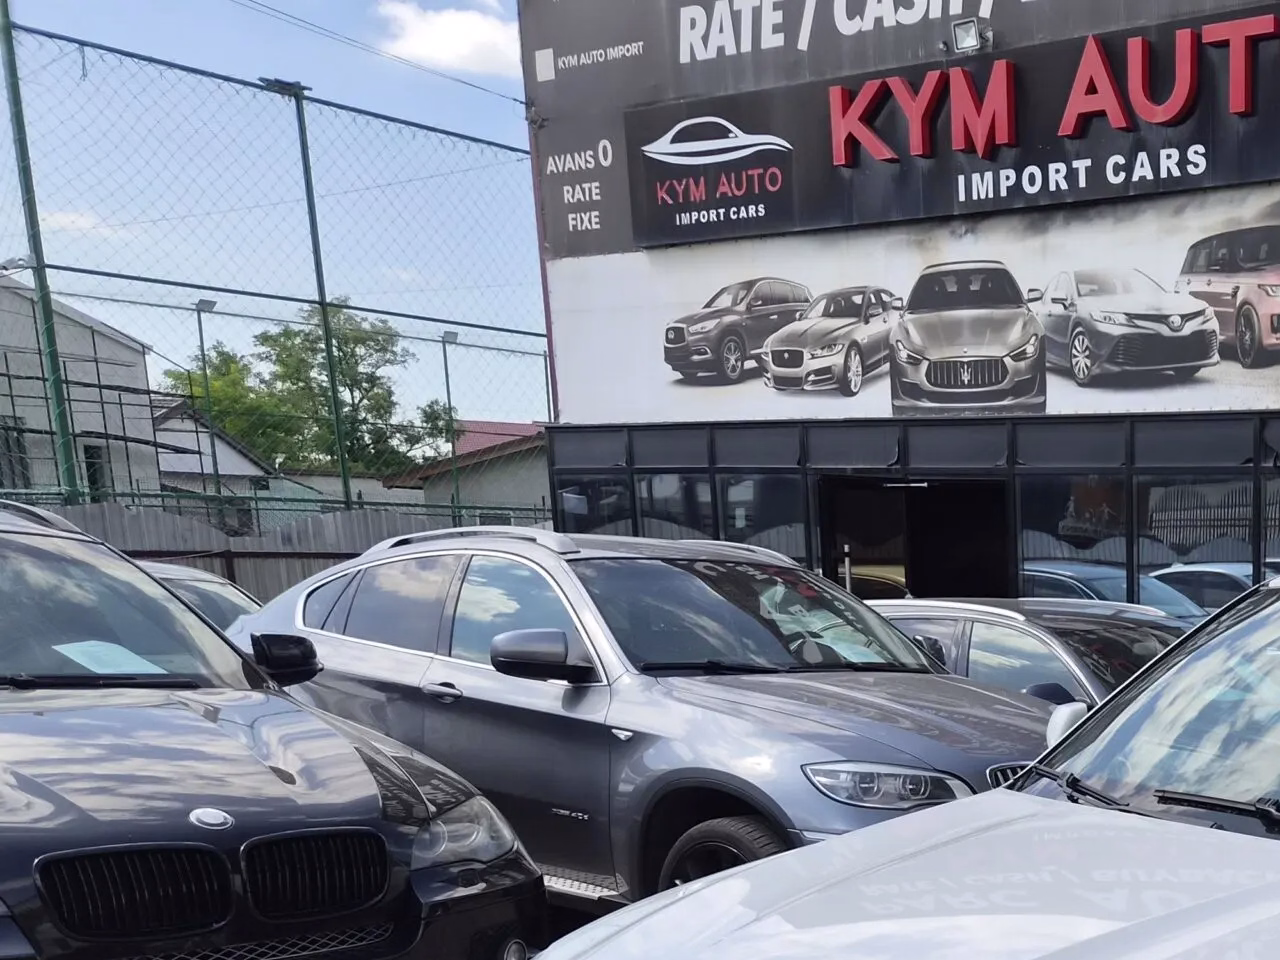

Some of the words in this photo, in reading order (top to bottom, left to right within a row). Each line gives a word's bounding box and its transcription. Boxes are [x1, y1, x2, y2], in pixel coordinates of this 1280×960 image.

[679, 0, 785, 64] RATE
[558, 54, 578, 70] KYM
[579, 49, 605, 66] AUTO
[606, 41, 644, 61] IMPORT
[829, 58, 1016, 167] KYM
[546, 150, 596, 175] AVANS
[957, 158, 1091, 203] IMPORT
[1105, 143, 1207, 184] CARS
[563, 181, 601, 204] RATE
[656, 176, 706, 205] KYM
[716, 167, 782, 198] AUTO
[567, 211, 600, 232] FIXE
[675, 208, 726, 226] IMPORT
[729, 203, 765, 220] CARS
